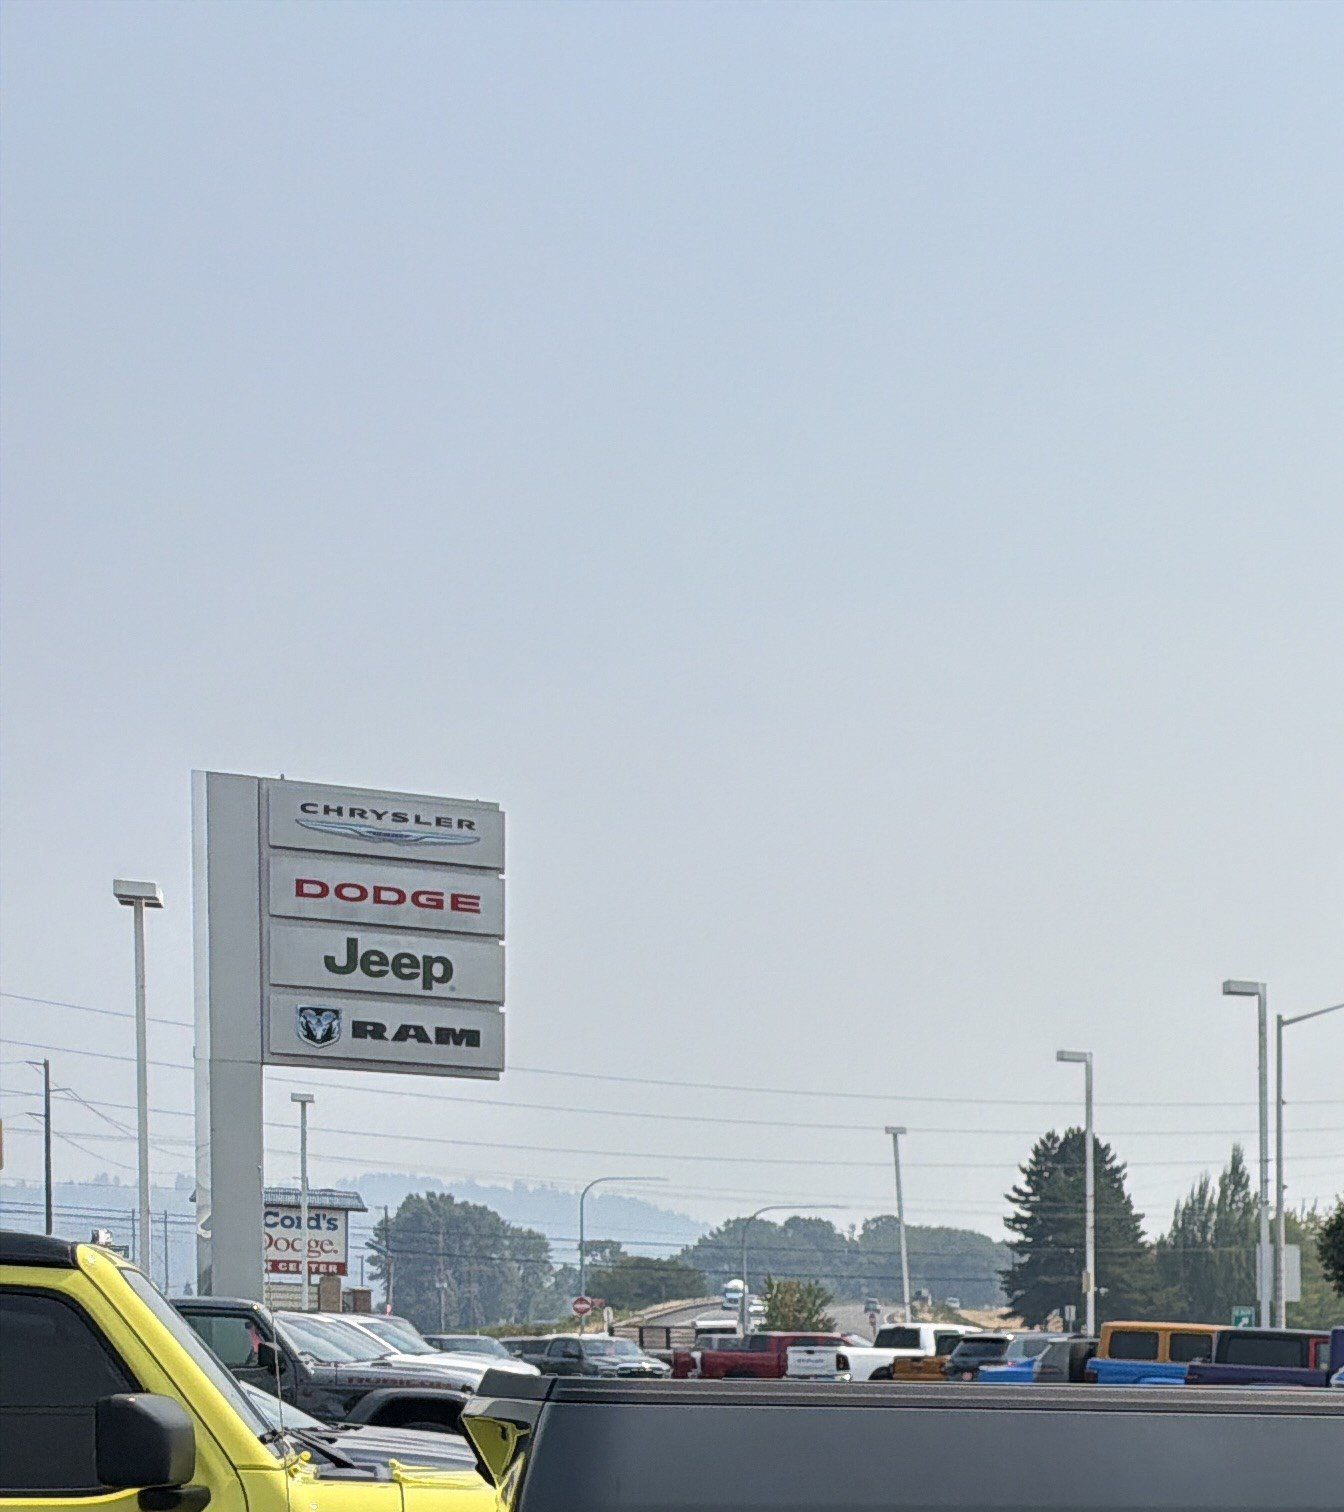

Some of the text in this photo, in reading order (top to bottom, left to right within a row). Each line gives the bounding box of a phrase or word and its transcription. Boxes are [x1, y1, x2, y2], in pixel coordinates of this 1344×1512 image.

[300, 802, 477, 832] CHRYSLER
[295, 878, 481, 914] DODGE
[323, 937, 454, 991] Jeep
[351, 1019, 481, 1048] RAM
[278, 1262, 338, 1273] CETER
